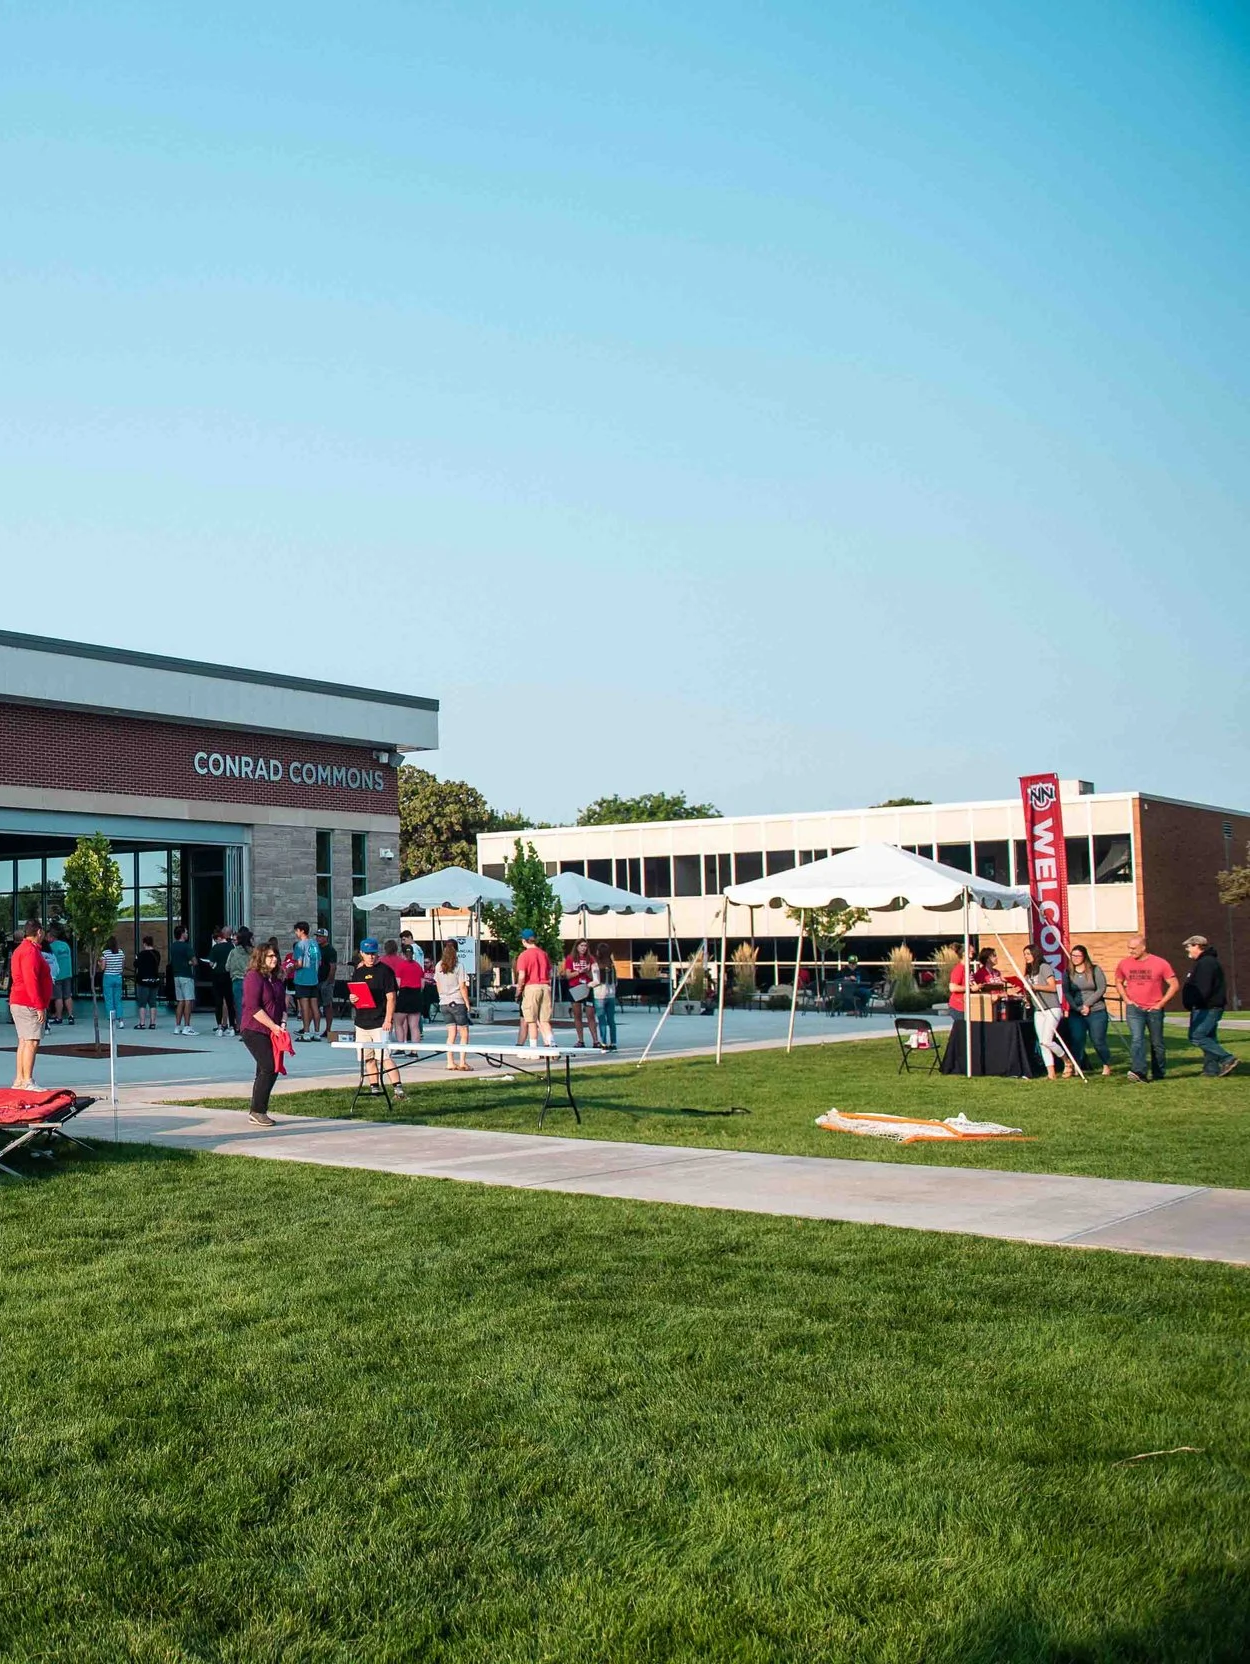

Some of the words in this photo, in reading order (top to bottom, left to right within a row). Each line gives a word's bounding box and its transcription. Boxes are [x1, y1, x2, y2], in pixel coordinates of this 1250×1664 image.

[194, 751, 283, 782] CONRAD
[289, 761, 385, 792] COMMONS
[1033, 817, 1063, 1004] WELCOM
